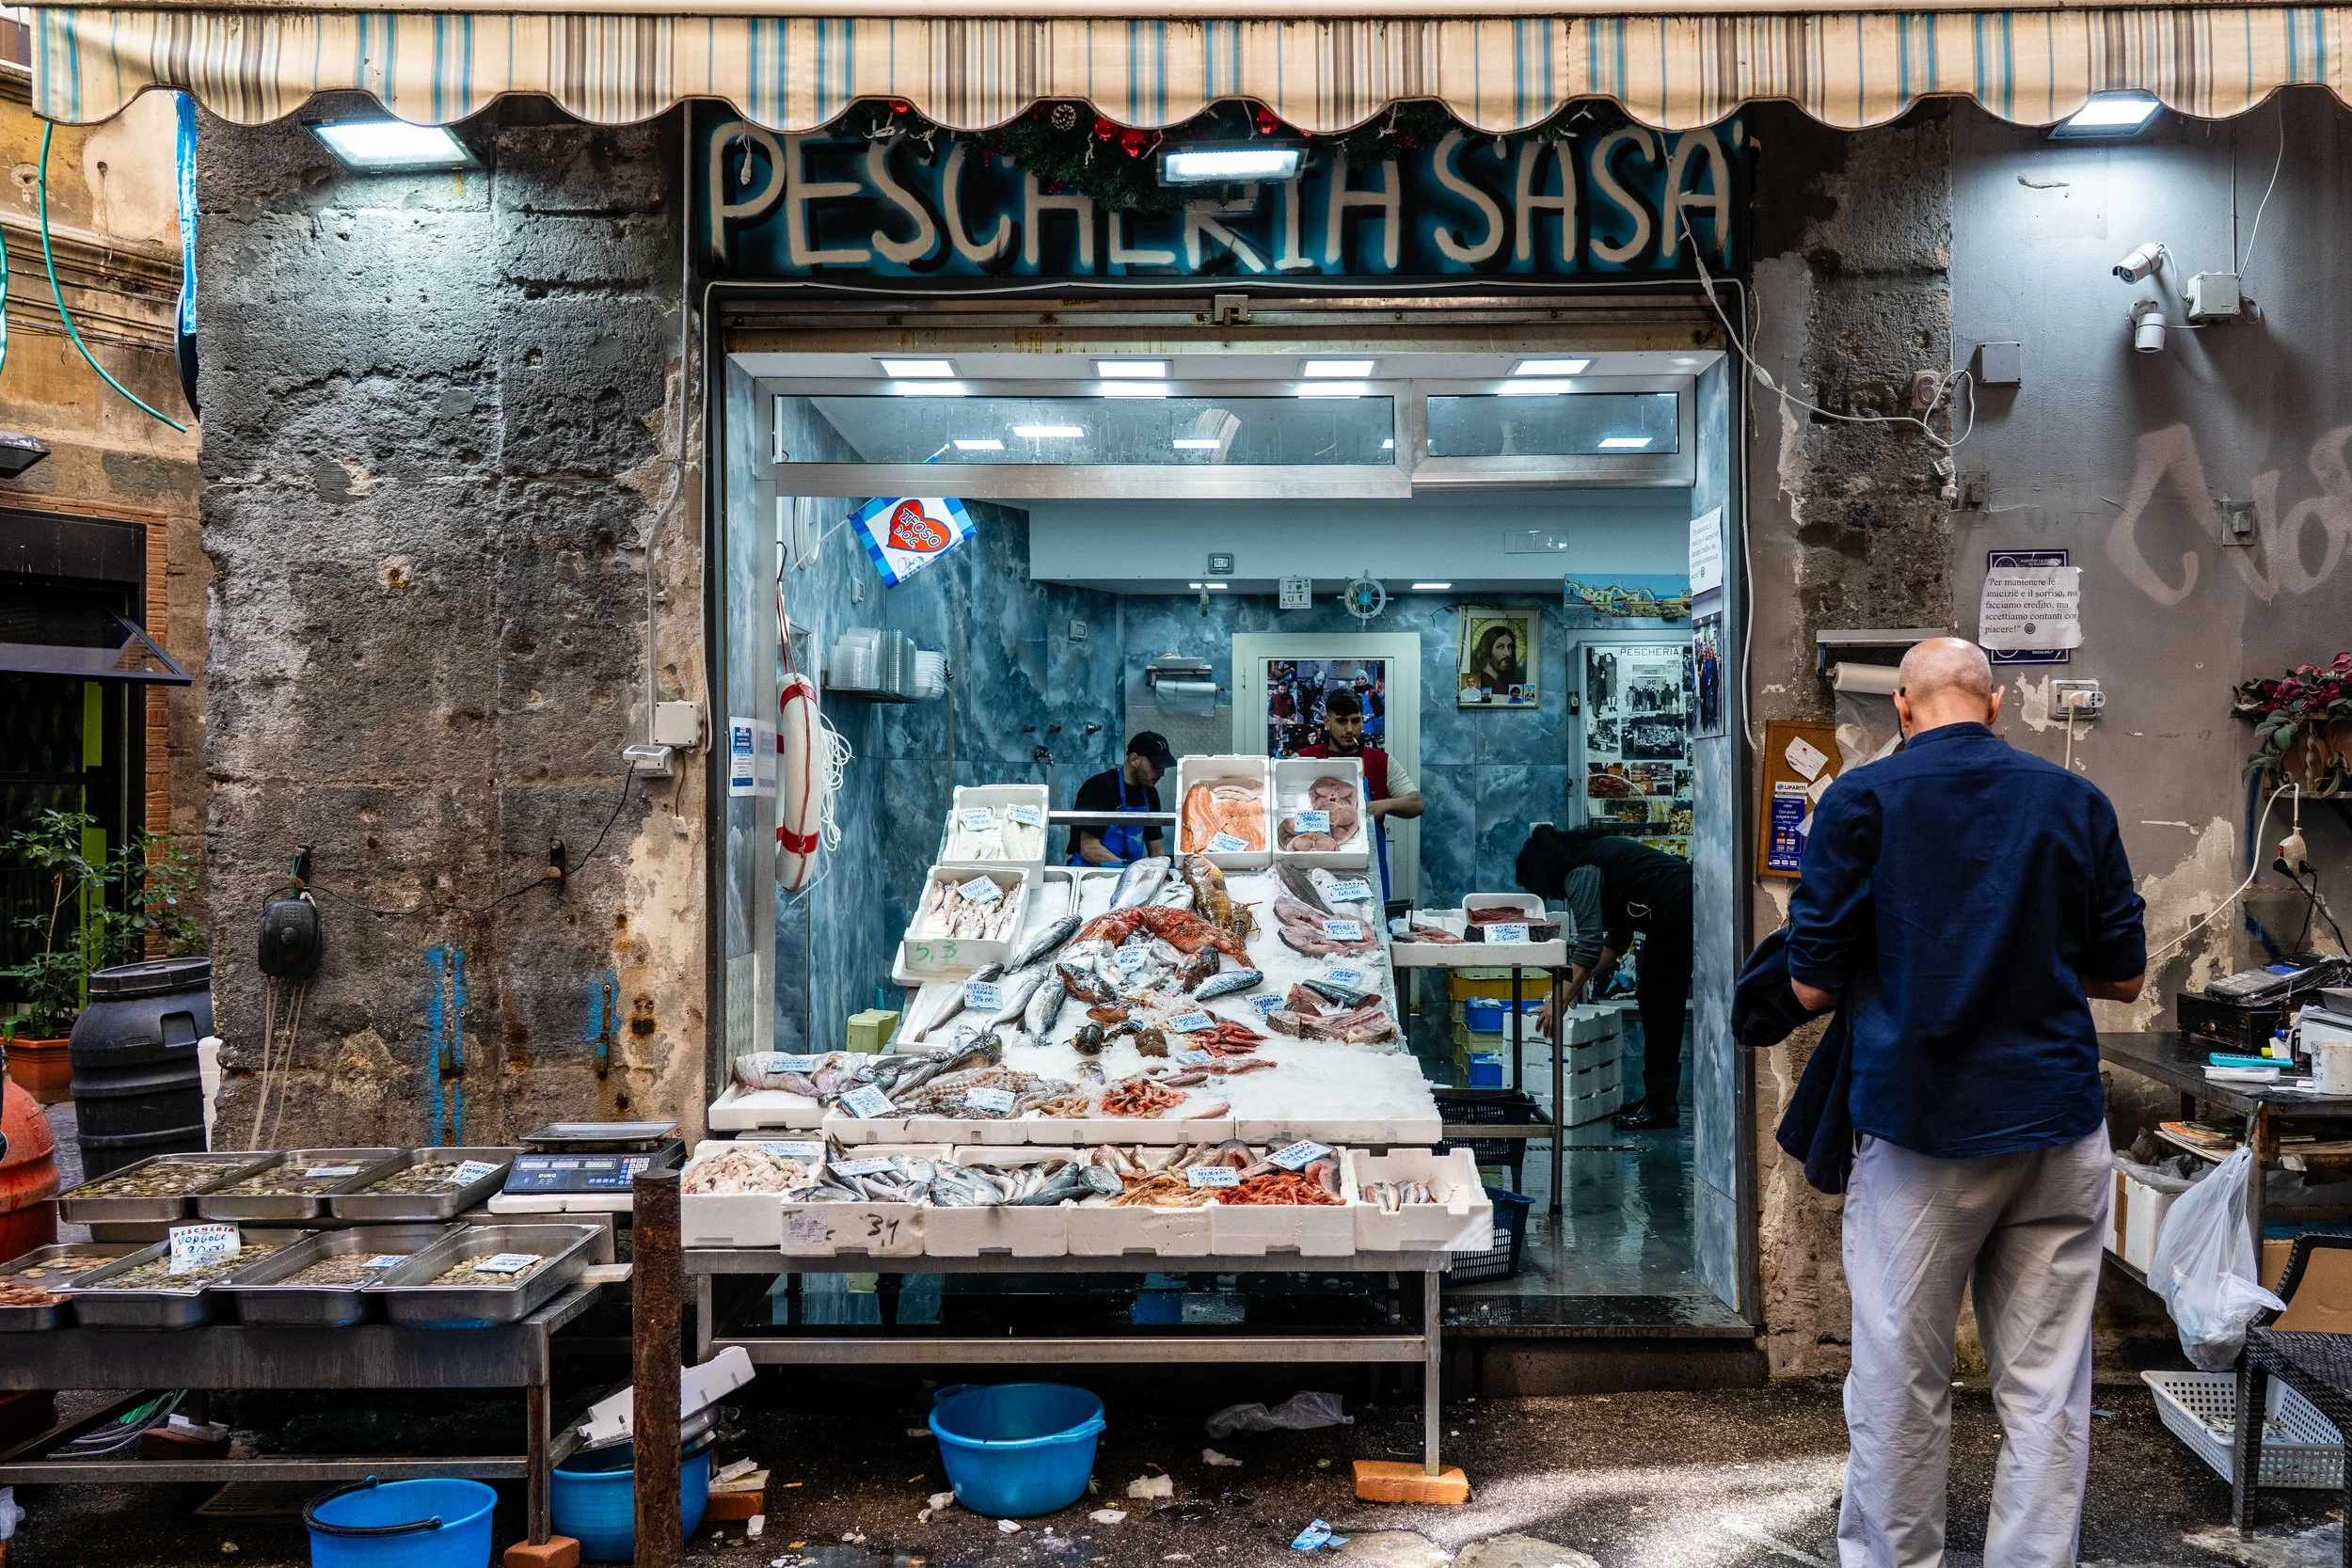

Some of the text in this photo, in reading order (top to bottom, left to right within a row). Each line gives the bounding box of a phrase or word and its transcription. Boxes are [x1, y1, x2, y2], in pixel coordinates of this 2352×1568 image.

[1917, 374, 1936, 405] 6
[898, 508, 942, 547] TIFOSO
[2048, 578, 2056, 586] le
[1986, 589, 2019, 597] amicizie
[2027, 589, 2033, 597] il
[2035, 589, 2065, 598] sorriso,
[1985, 600, 2022, 609] facciamo
[1985, 612, 2027, 621] accettiamo
[2029, 611, 2062, 620] contanti
[1620, 647, 1679, 657] PESCHERIA
[173, 1226, 234, 1239] PESCHERIA
